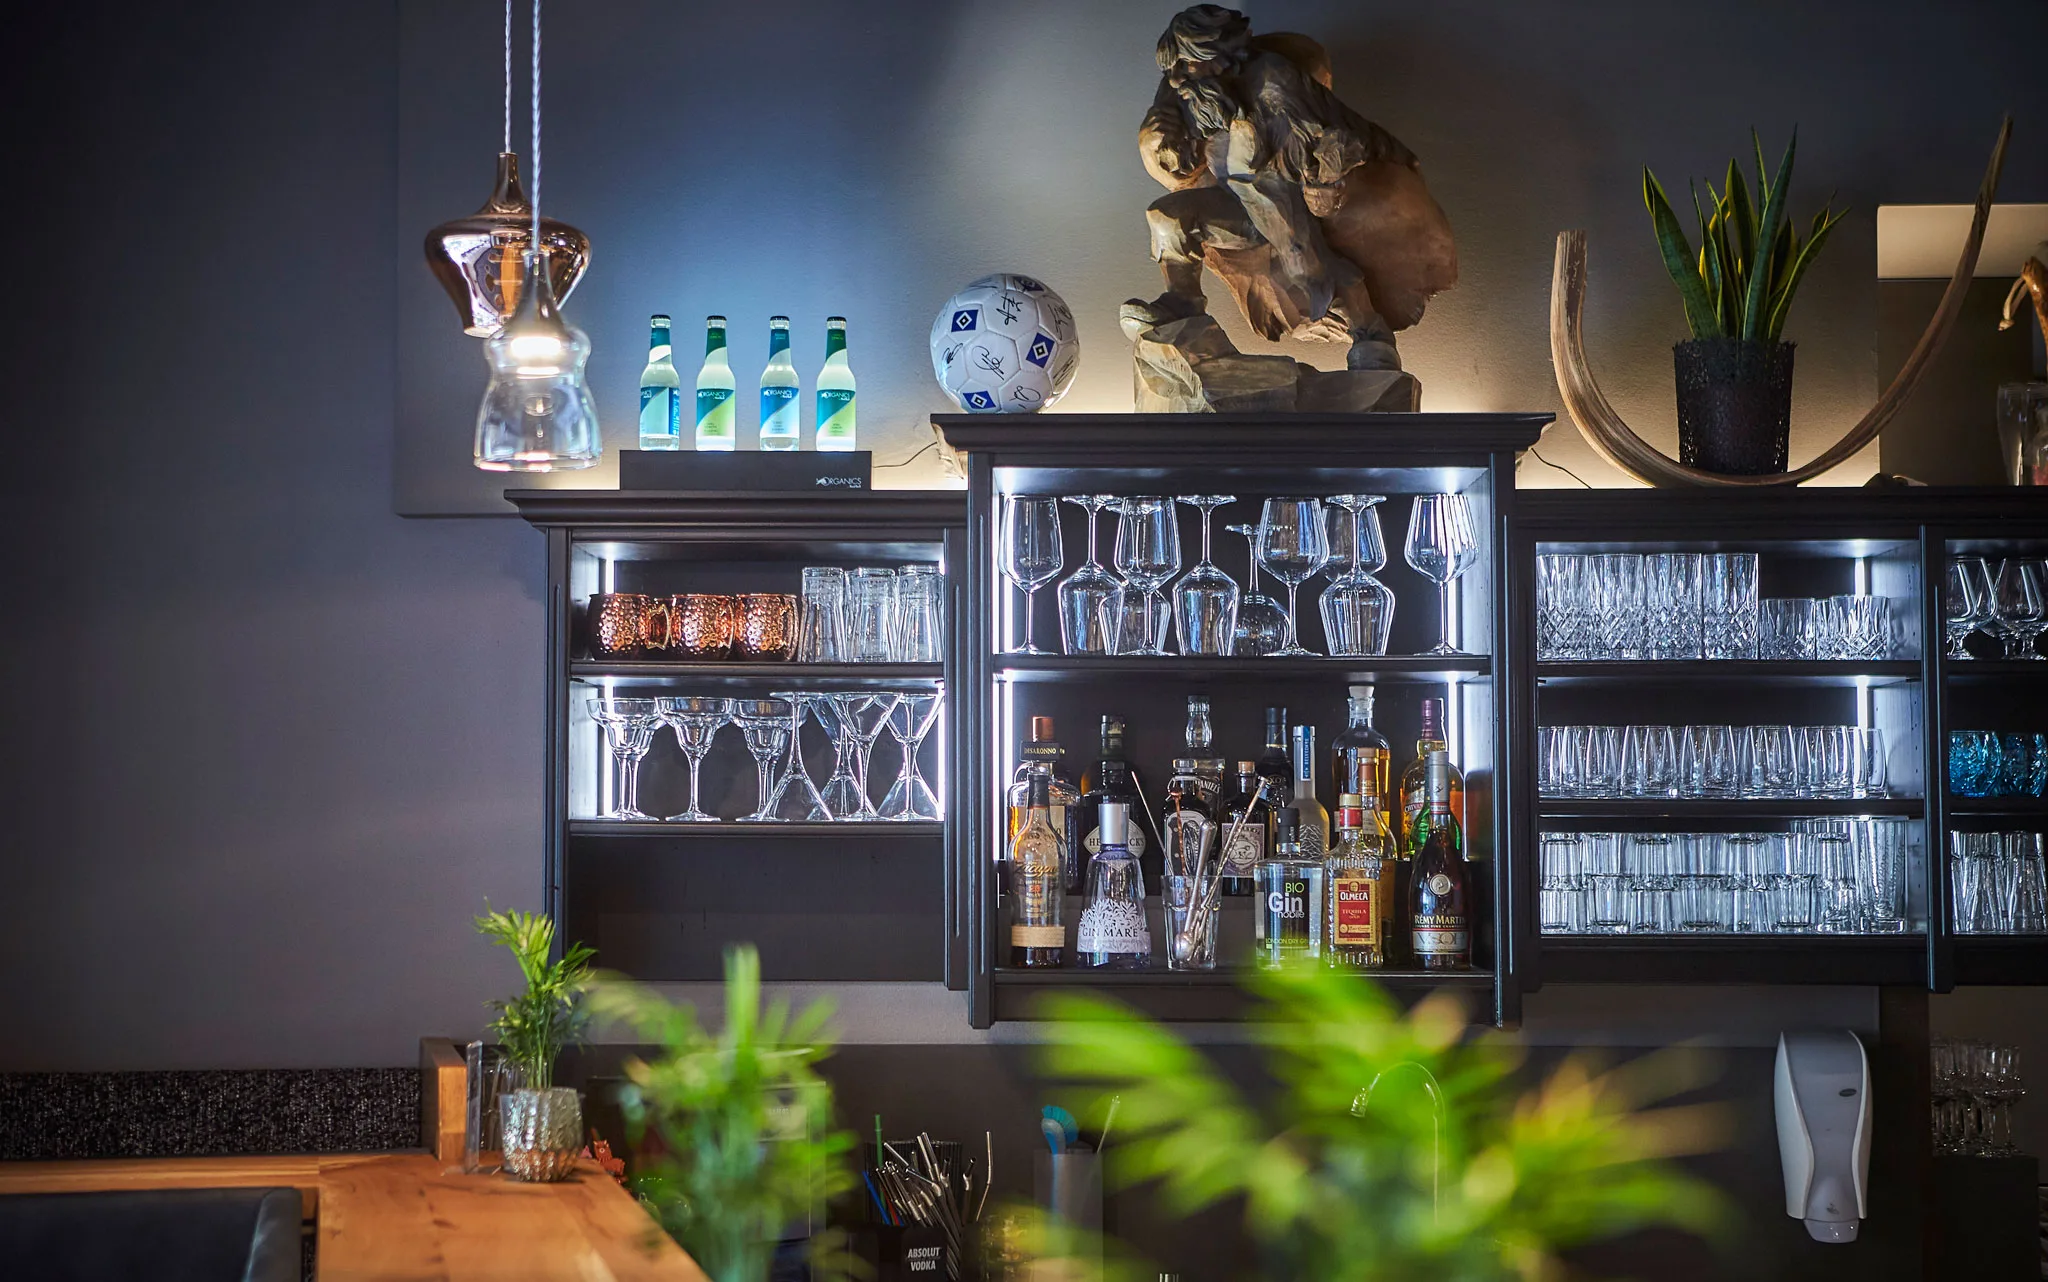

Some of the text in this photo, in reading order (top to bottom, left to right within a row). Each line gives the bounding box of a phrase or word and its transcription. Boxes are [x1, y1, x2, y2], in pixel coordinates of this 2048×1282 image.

[822, 476, 862, 486] ORGANICS
[1024, 747, 1057, 755] DISARONNO
[1285, 882, 1305, 893] BIO
[1340, 892, 1368, 901] OLMECA
[1268, 892, 1303, 913] Gin
[1277, 910, 1305, 919] nobile
[1082, 927, 1139, 938] GIN MARE
[908, 1247, 941, 1258] ABSOLUT
[910, 1260, 936, 1271] VODKA
